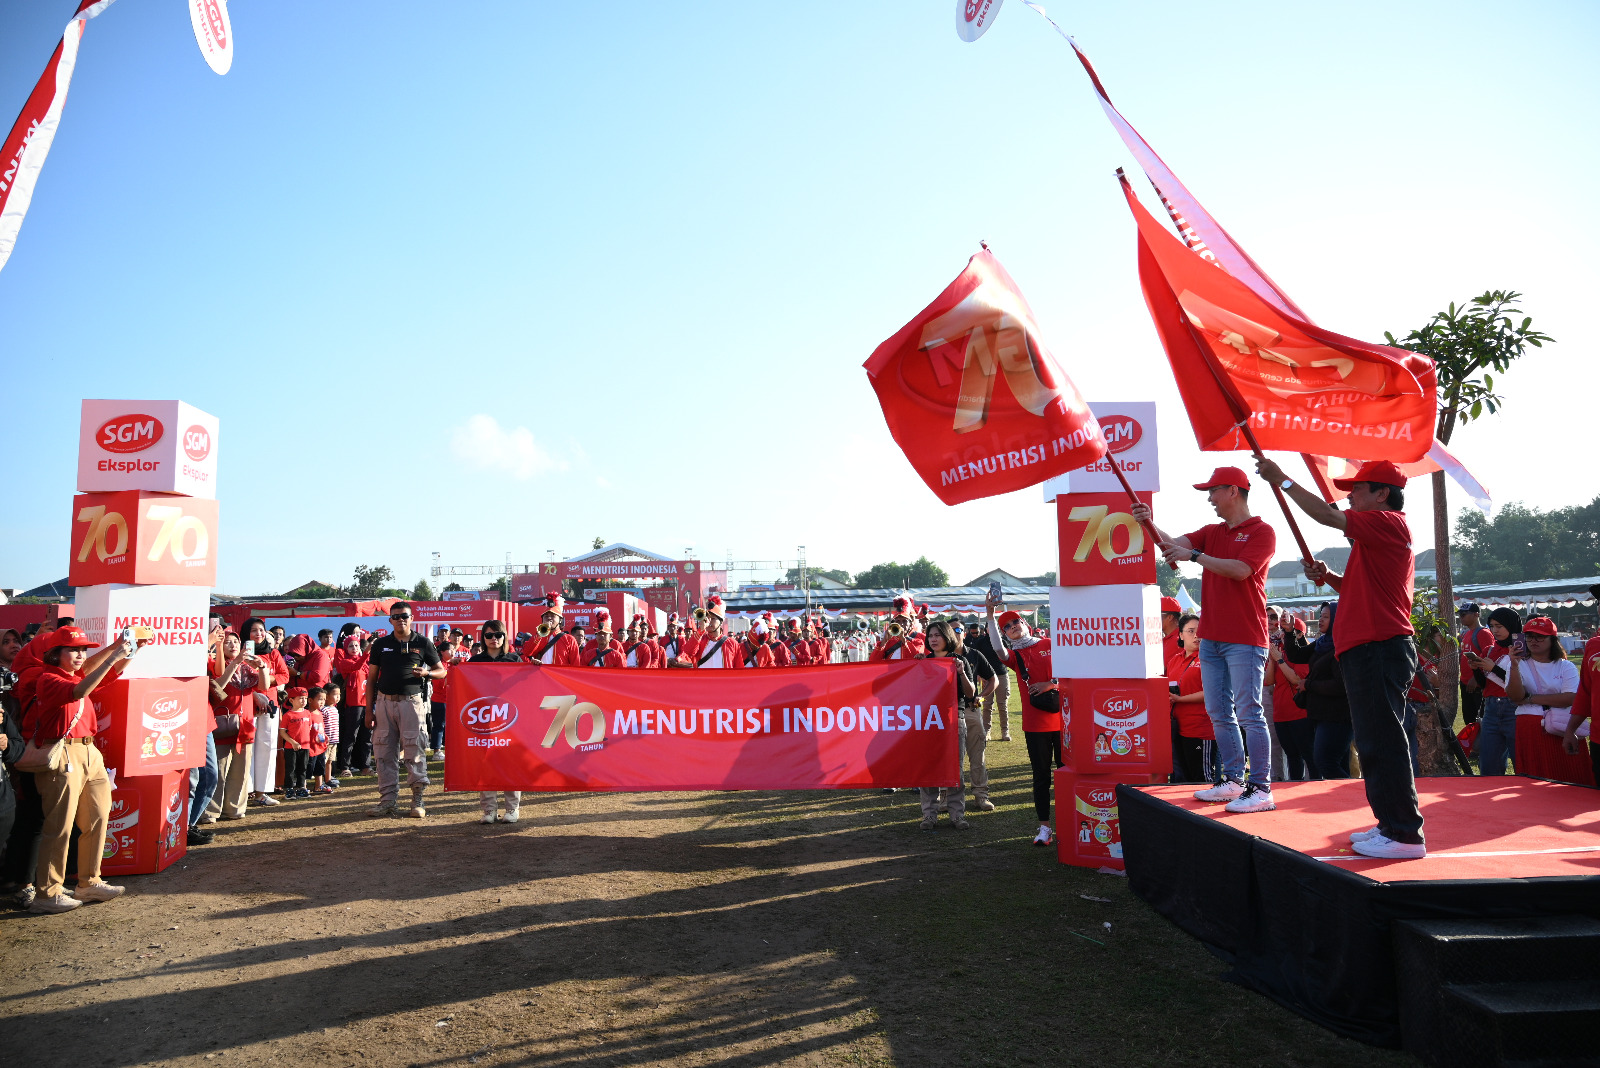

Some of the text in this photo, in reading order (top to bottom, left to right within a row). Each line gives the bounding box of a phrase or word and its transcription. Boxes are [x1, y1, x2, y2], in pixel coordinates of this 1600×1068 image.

[103, 420, 155, 445] SGM
[1102, 421, 1133, 444] GM
[1283, 414, 1412, 442] INDONESIA
[185, 431, 209, 453] SGM
[97, 458, 161, 474] Eksplor
[940, 445, 1046, 487] MENUTRISI
[77, 504, 129, 563] 70
[145, 504, 209, 565] 70
[1068, 504, 1145, 564] 70
[107, 555, 126, 565] TAHUN
[1117, 555, 1143, 566] TAHUN
[582, 565, 629, 575] MENUTRISI
[630, 564, 677, 574] INDONESIA
[1056, 616, 1140, 631] MENUTRISI
[113, 631, 204, 646] INESIA
[1056, 632, 1142, 647] INDONESIA
[155, 699, 178, 715] SGM
[1107, 699, 1133, 713] SGM
[467, 702, 509, 726] SGM
[539, 694, 945, 750] 70 MENUTRISI INDONESIA
[1105, 720, 1136, 729] Eksplor
[467, 736, 512, 749] Eksplor
[1133, 733, 1146, 746] 3+
[580, 743, 604, 752] TAHUN
[1091, 791, 1113, 802] SGM
[106, 821, 125, 831] plor
[121, 835, 135, 848] 5+
